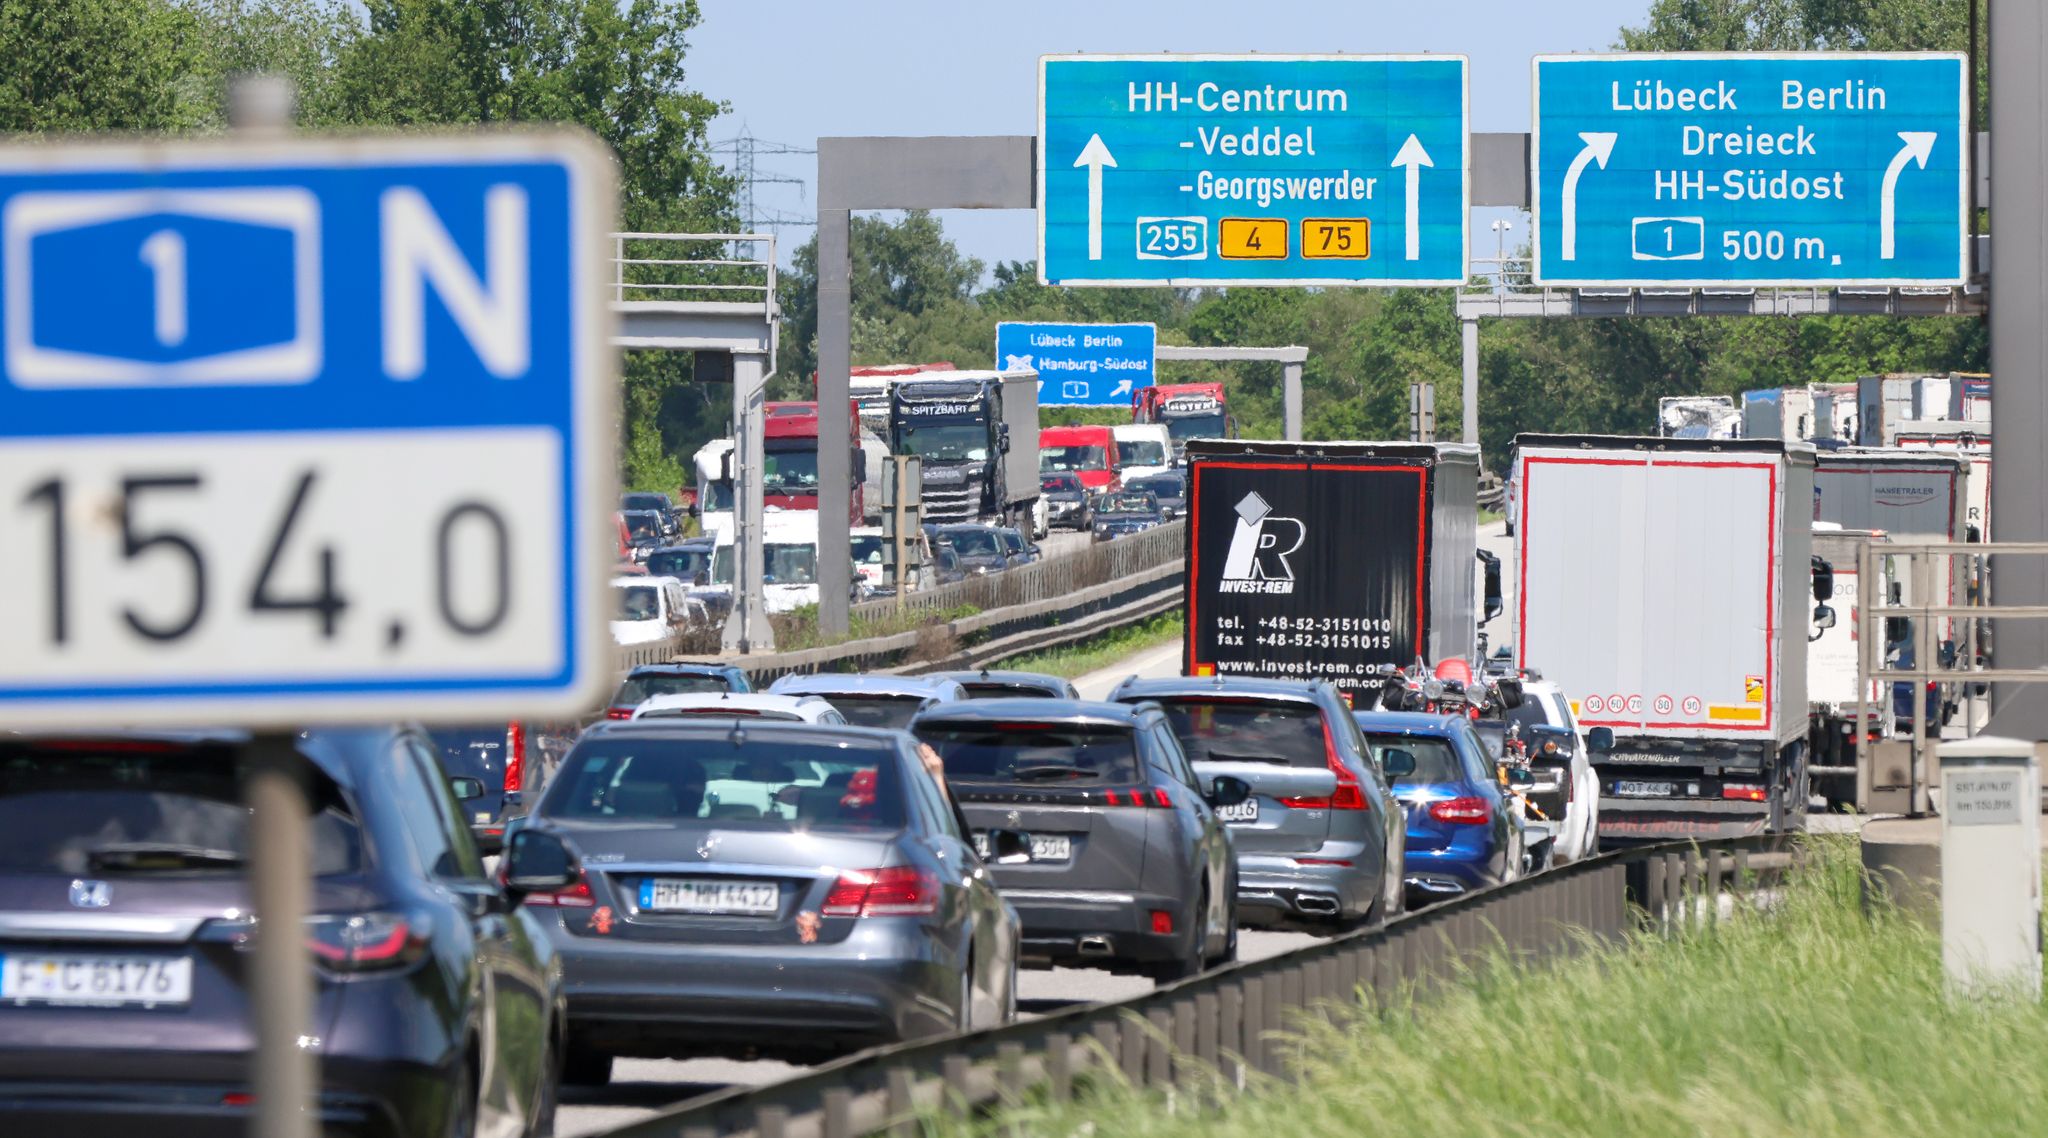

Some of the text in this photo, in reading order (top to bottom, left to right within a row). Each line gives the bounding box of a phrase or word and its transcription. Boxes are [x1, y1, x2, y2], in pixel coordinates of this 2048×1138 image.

[1128, 81, 1348, 112] HH-Centrum
[1612, 79, 1886, 111] Lübeck Berlin
[1683, 125, 1816, 155] Dreieck
[1654, 169, 1844, 200] HH-Südost
[1146, 225, 1352, 252] 255 4 75
[1663, 226, 1673, 251] 1
[1723, 230, 1785, 260] 500
[139, 184, 532, 381] 1 N
[1030, 333, 1123, 348] Lübeck Berlin
[1039, 357, 1148, 373] Hamburg-Südost
[912, 404, 968, 416] SPITZBART
[1874, 487, 1934, 495] HANSETRAILER
[20, 467, 513, 655] 154,0
[1218, 580, 1294, 594] INVEST-REM
[1217, 616, 1392, 633] tel. +48-52-3151010
[1217, 633, 1391, 649] fax +48-52-3151015
